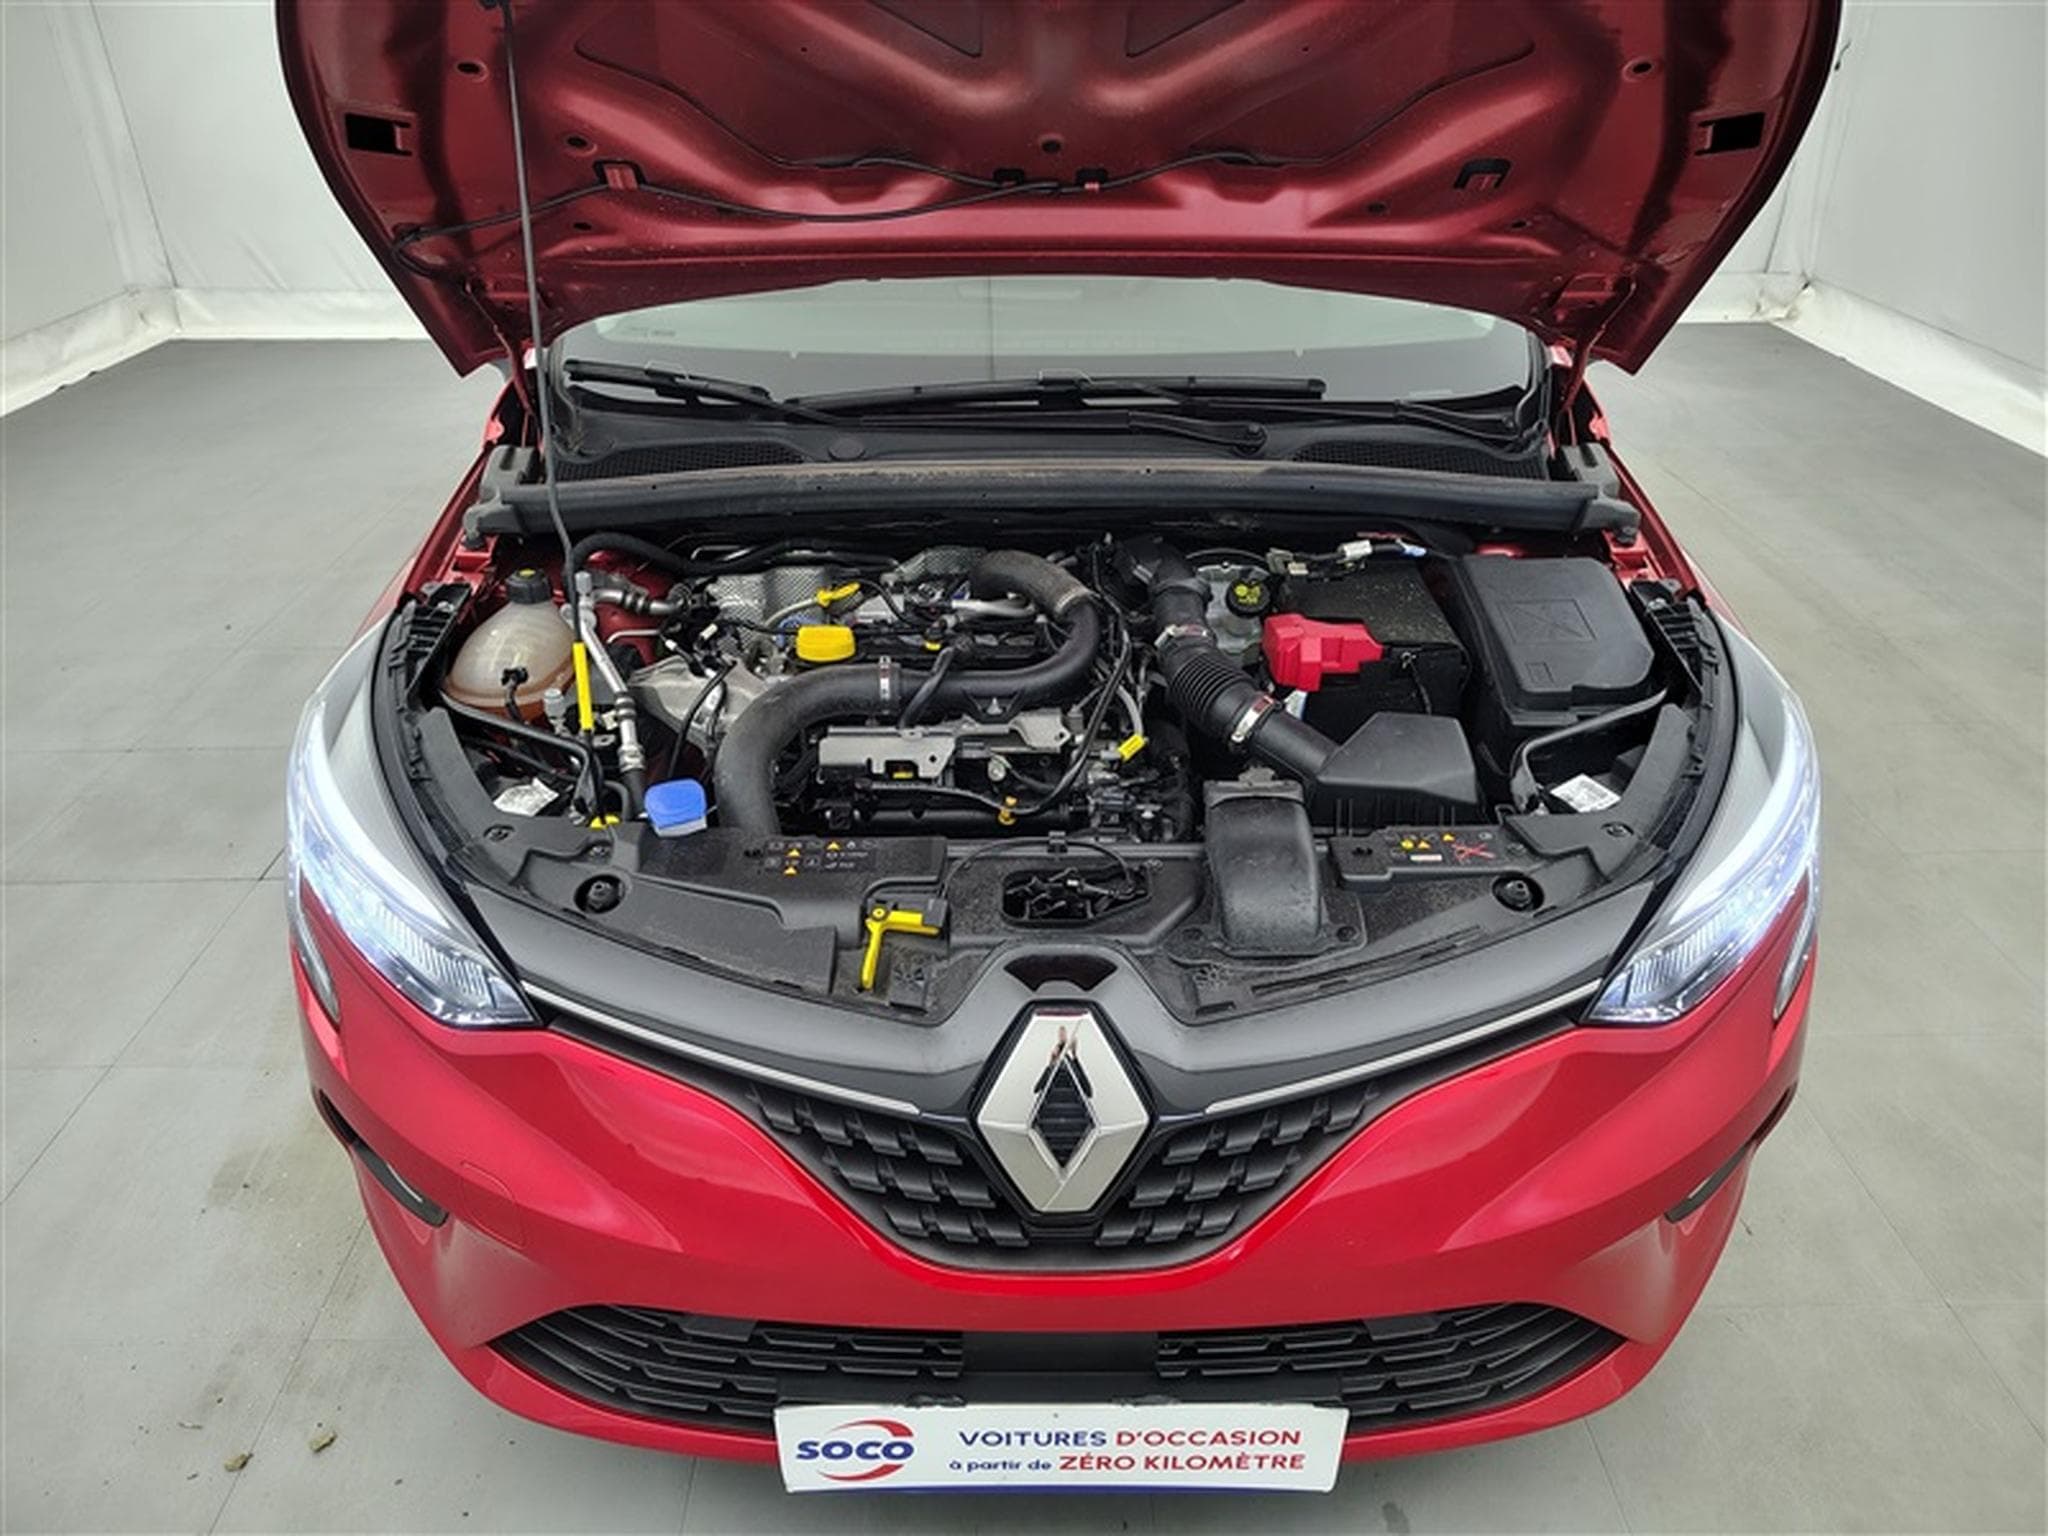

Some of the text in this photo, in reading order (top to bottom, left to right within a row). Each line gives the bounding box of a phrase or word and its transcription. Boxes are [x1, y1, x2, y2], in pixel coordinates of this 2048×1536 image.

[959, 1430, 1302, 1447] VOITURES D'OCCASION
[796, 1440, 914, 1460] SOCO
[949, 1452, 1305, 1472] à partir de ZÉRO KILOMÈTRE
